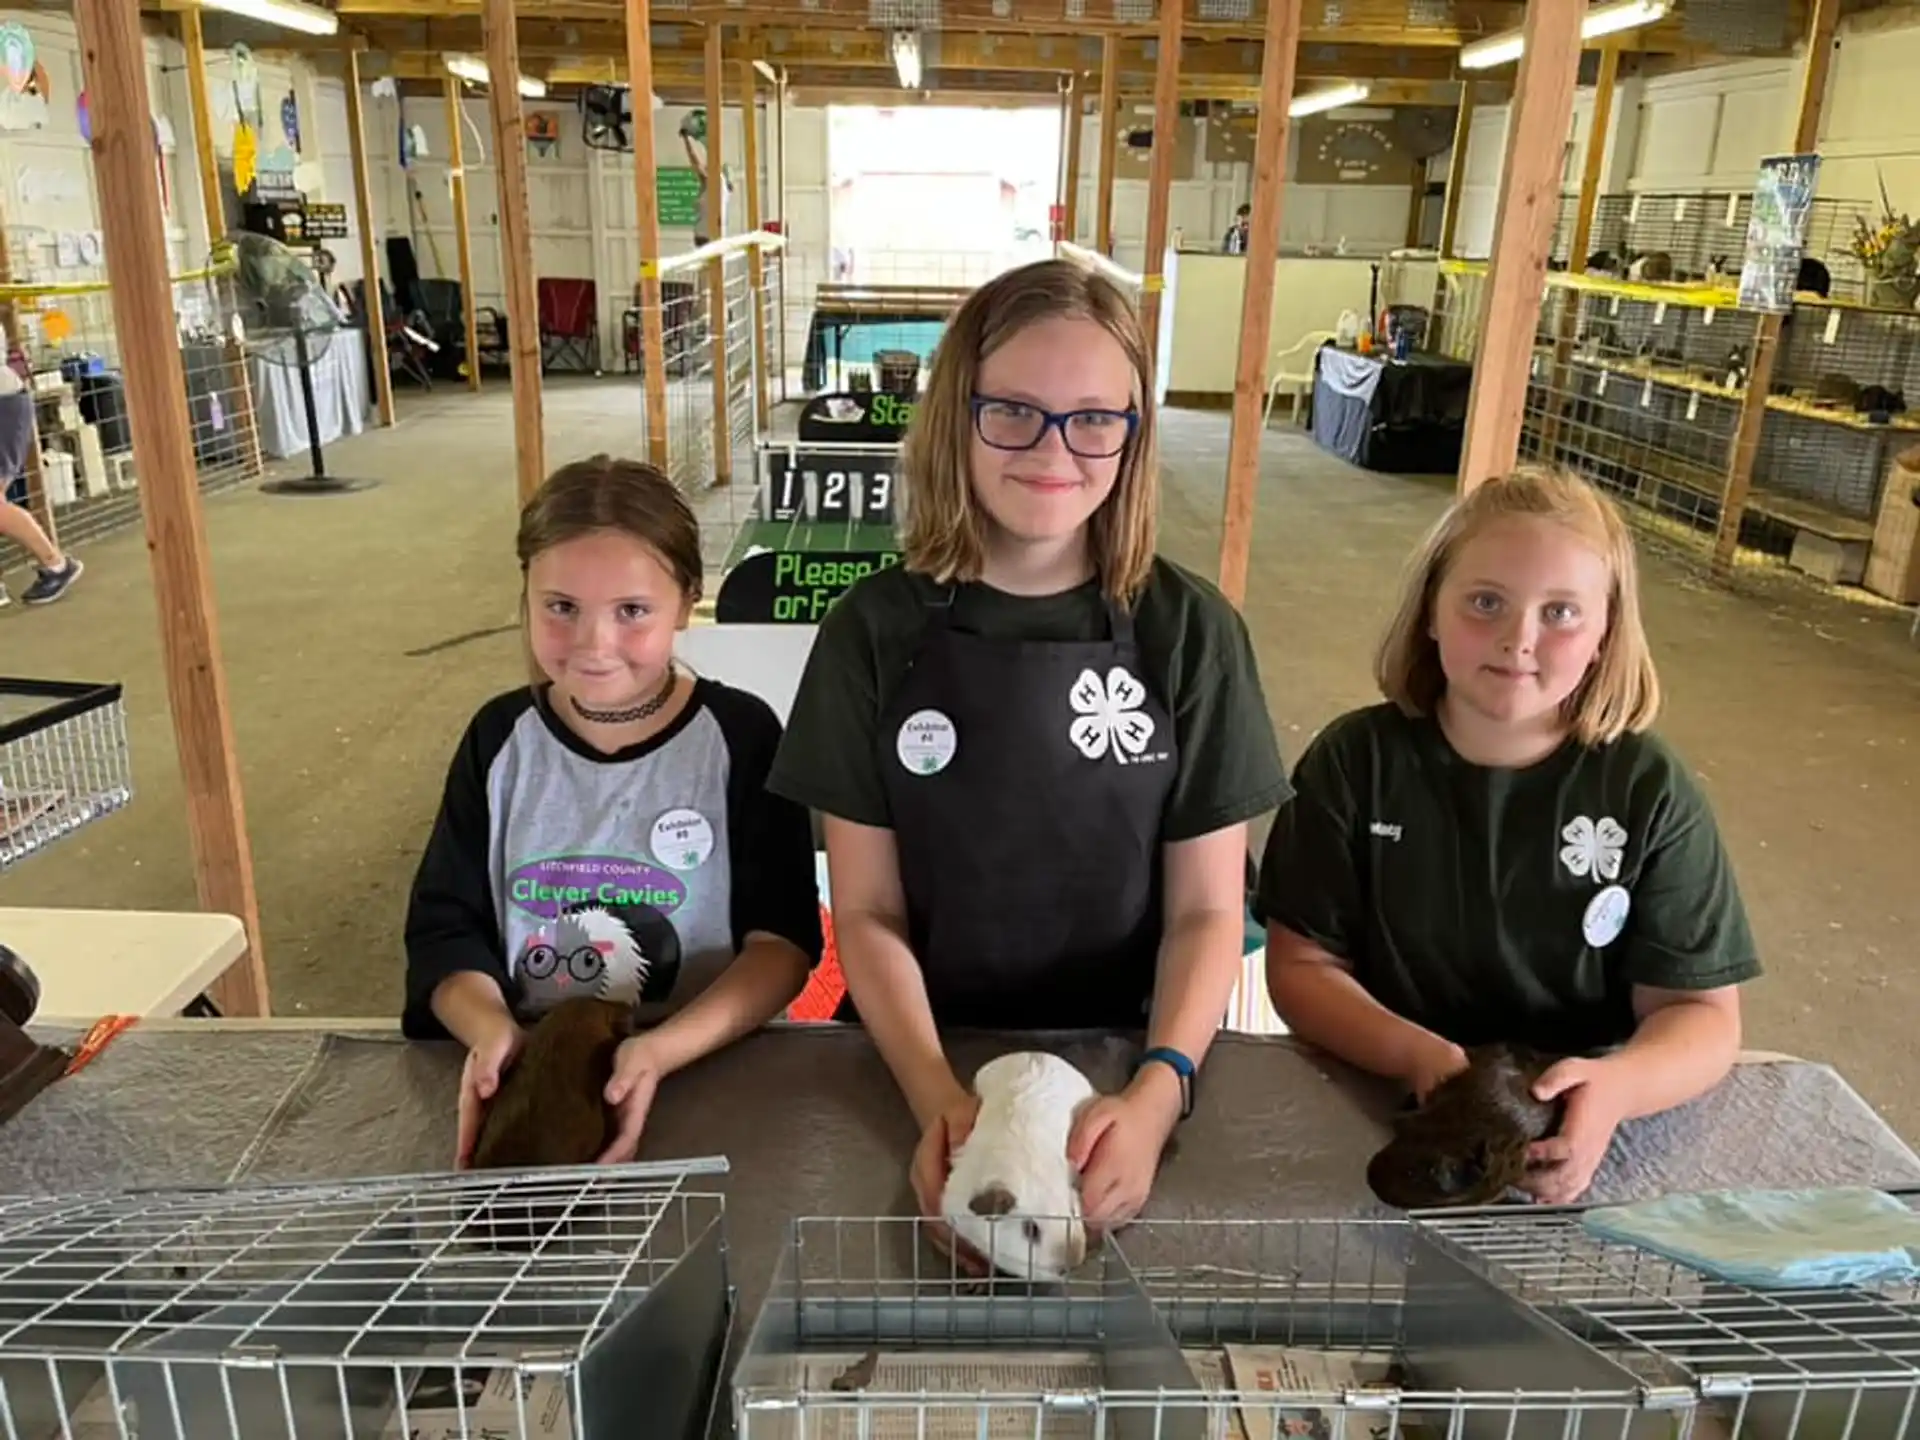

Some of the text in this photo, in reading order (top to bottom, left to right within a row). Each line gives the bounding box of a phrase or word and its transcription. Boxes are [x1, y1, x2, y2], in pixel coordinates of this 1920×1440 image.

[782, 471, 891, 510] 1 2 3
[1078, 684, 1096, 705] H
[1115, 681, 1133, 702] H
[1080, 725, 1101, 747] H
[1125, 720, 1145, 742] H
[512, 879, 680, 905] Clever Cavies
